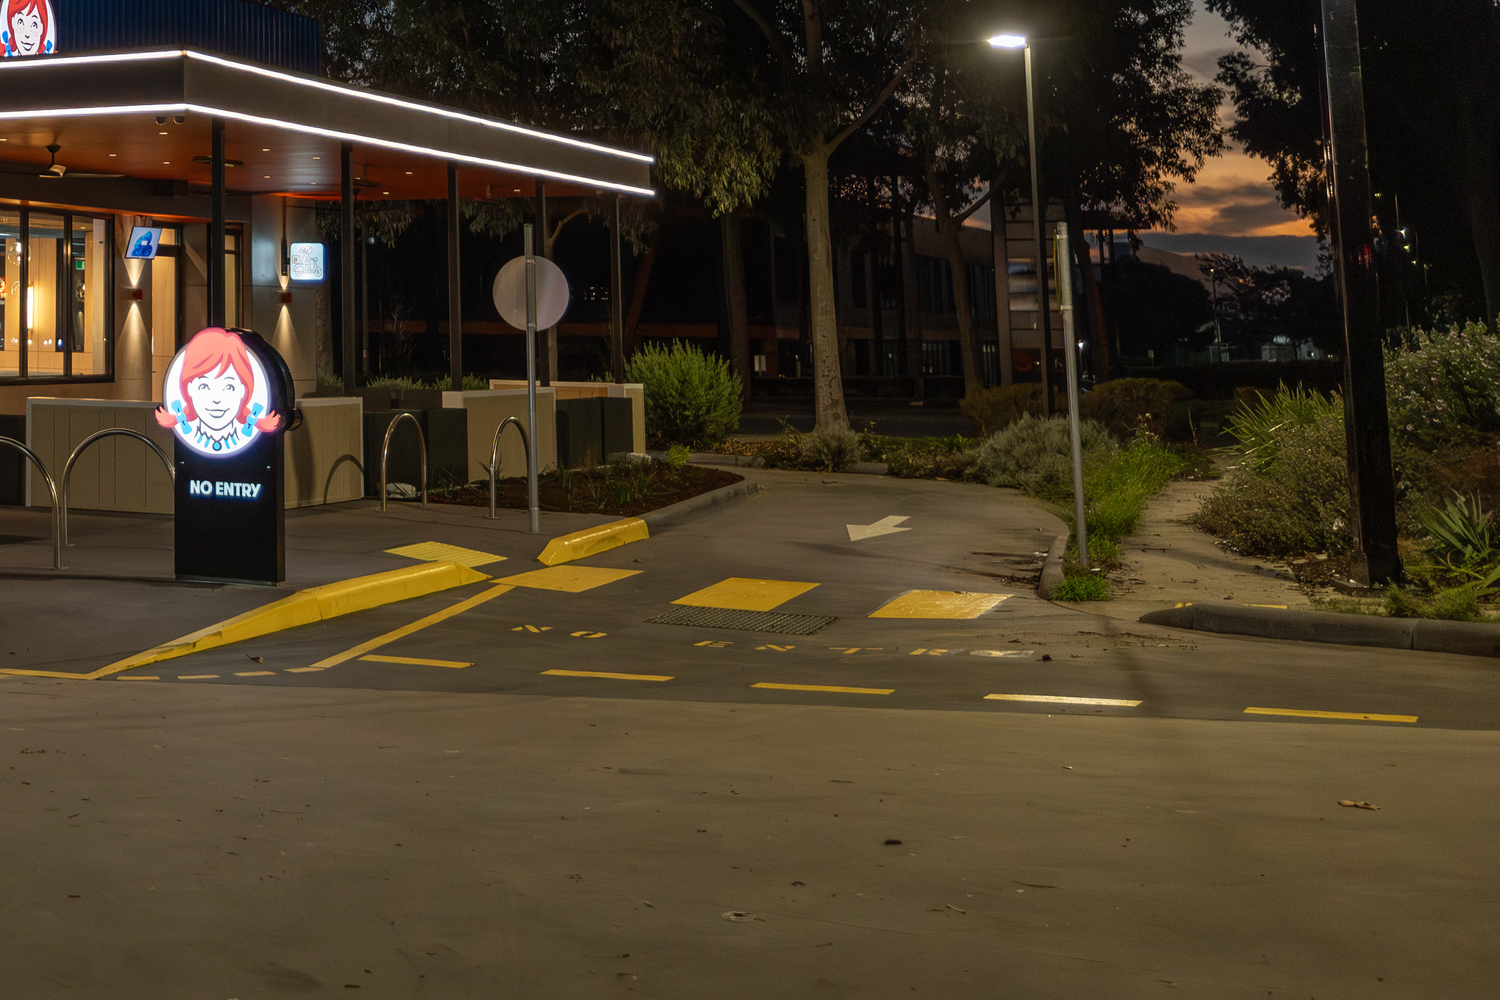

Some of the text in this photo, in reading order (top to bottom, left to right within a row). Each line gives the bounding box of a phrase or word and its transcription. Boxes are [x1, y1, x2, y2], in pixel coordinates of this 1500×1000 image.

[190, 480, 261, 497] NO ENTRY
[511, 624, 607, 638] NO
